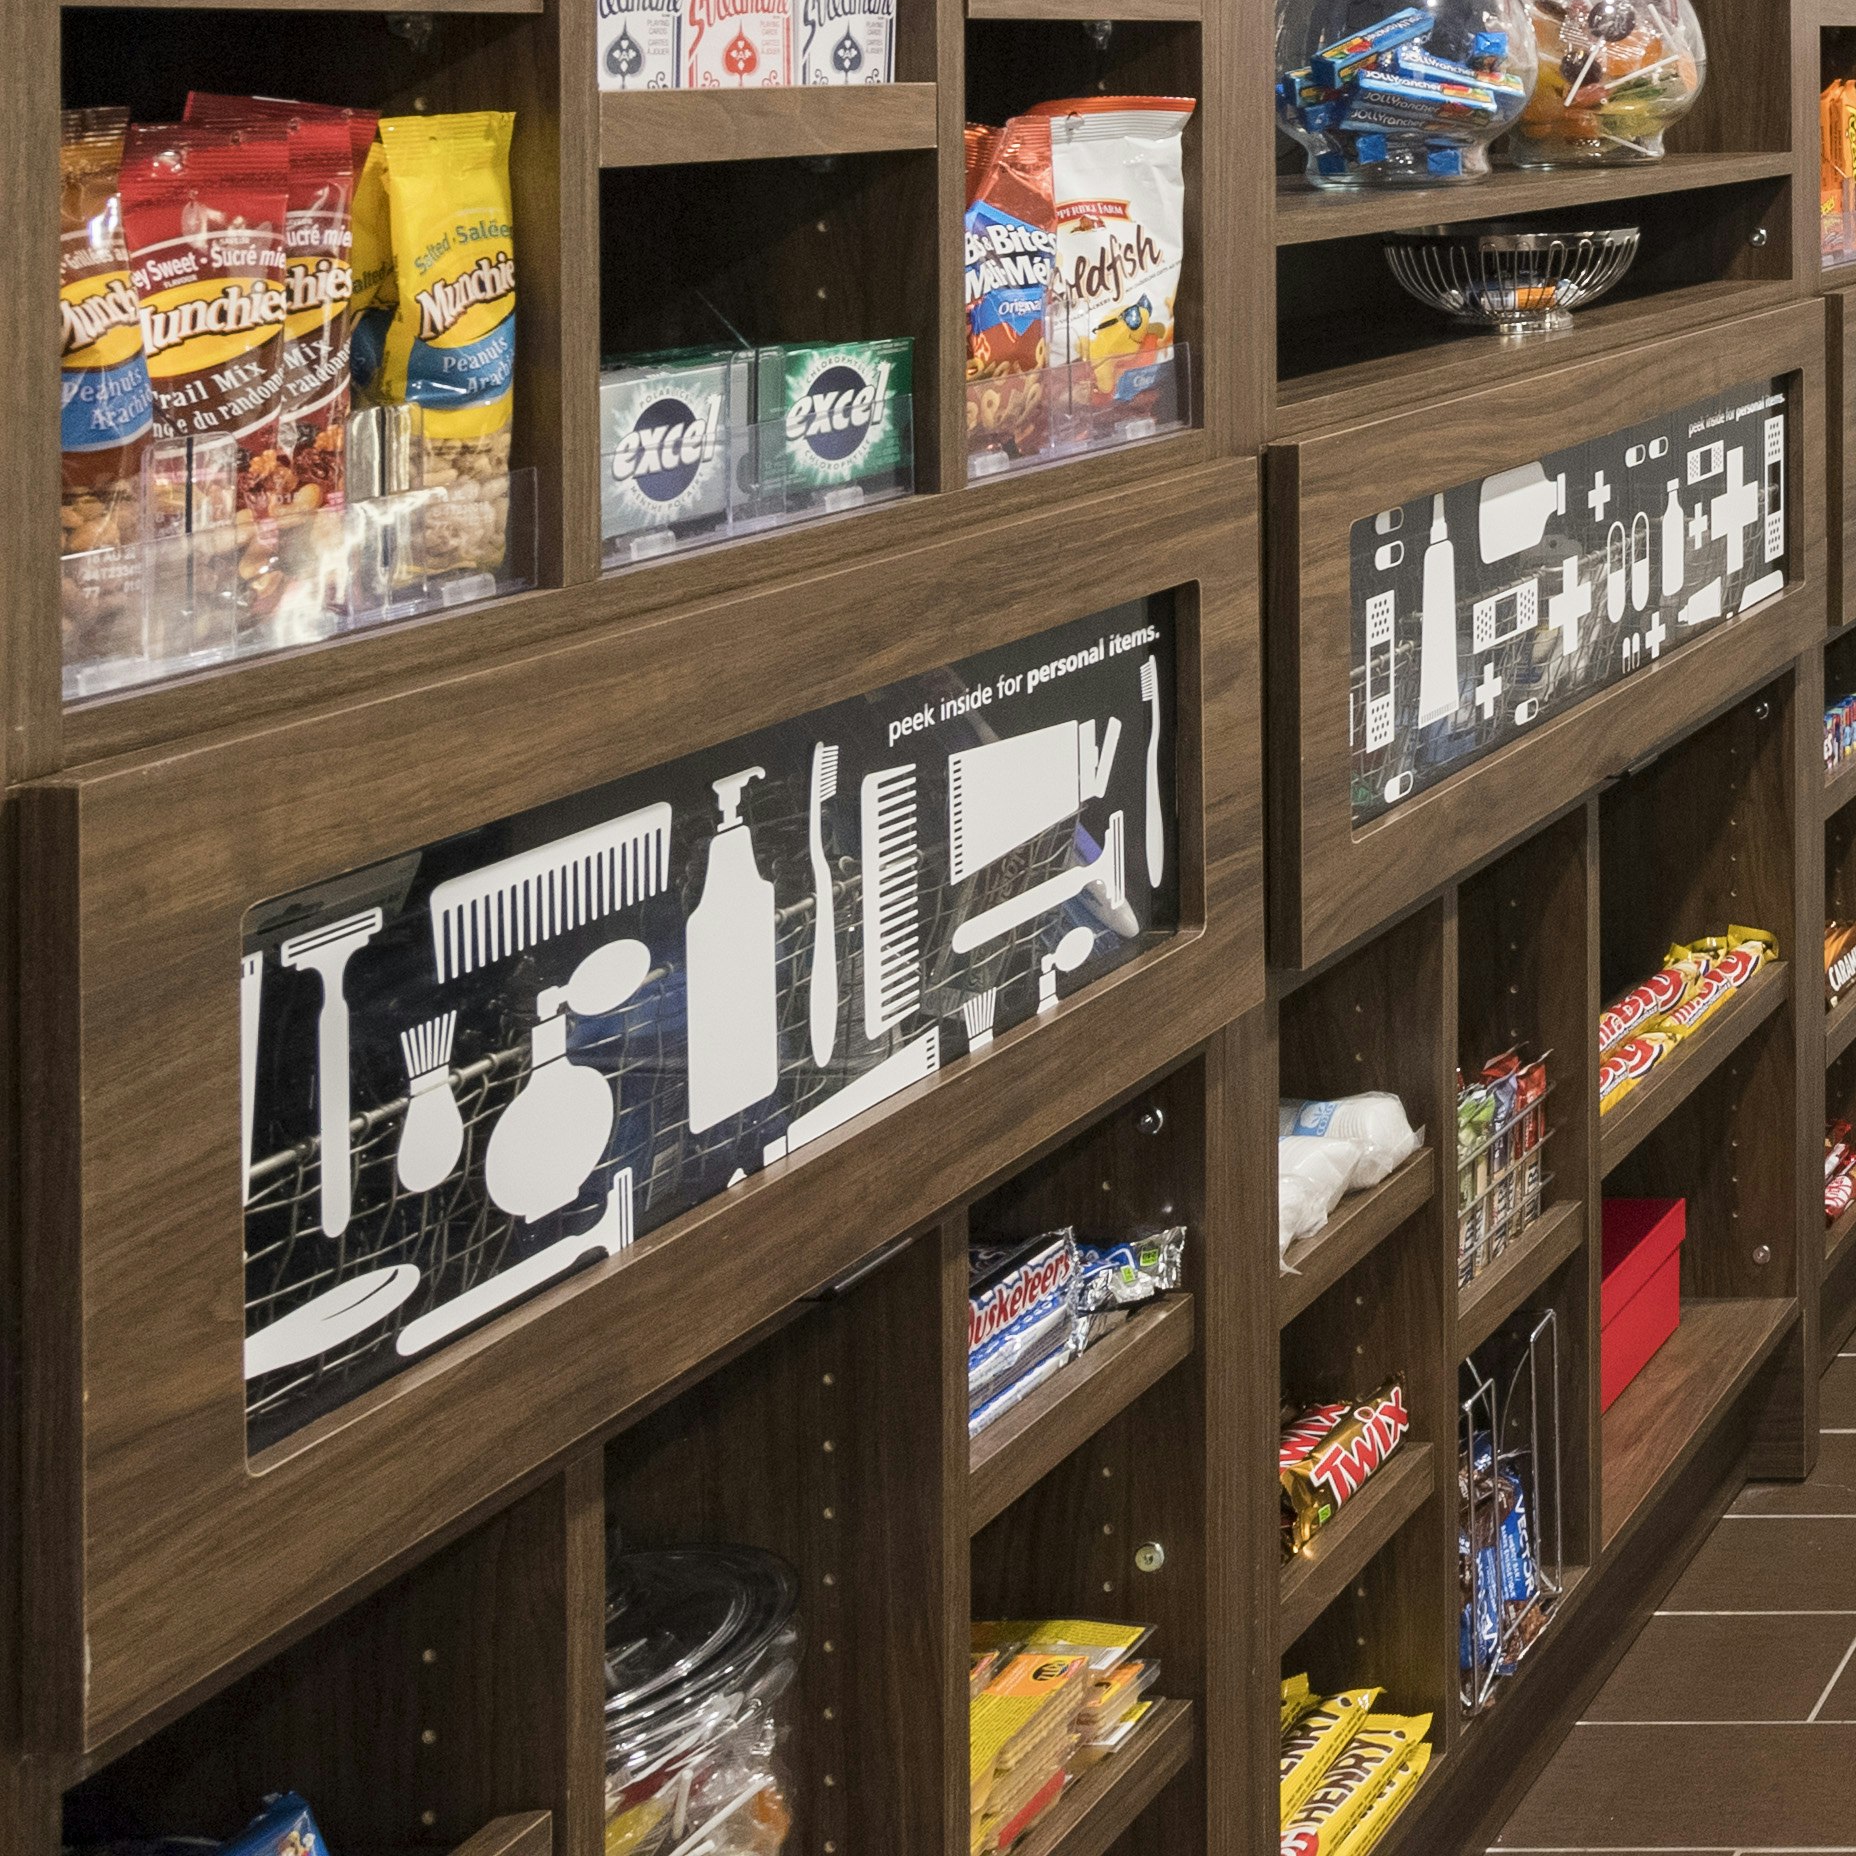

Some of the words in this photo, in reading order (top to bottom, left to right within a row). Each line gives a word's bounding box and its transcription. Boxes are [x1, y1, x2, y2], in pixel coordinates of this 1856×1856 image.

[1099, 203, 1124, 215] FARM
[414, 234, 451, 275] Salted
[987, 224, 1057, 255] Bites
[147, 252, 198, 281] Sweet
[210, 246, 256, 268] Sucré
[284, 338, 333, 369] Mix
[443, 336, 508, 374] Peanuts
[62, 368, 142, 405] Peanuts
[211, 361, 266, 392] Mix
[785, 360, 892, 442] excel
[193, 411, 218, 430] du
[612, 394, 722, 481] excel
[889, 703, 935, 747] peek
[940, 683, 992, 721] inside
[997, 674, 1023, 699] for
[1027, 637, 1105, 694] personal
[1108, 624, 1160, 657] items.
[1515, 1494, 1535, 1595] VECTOR
